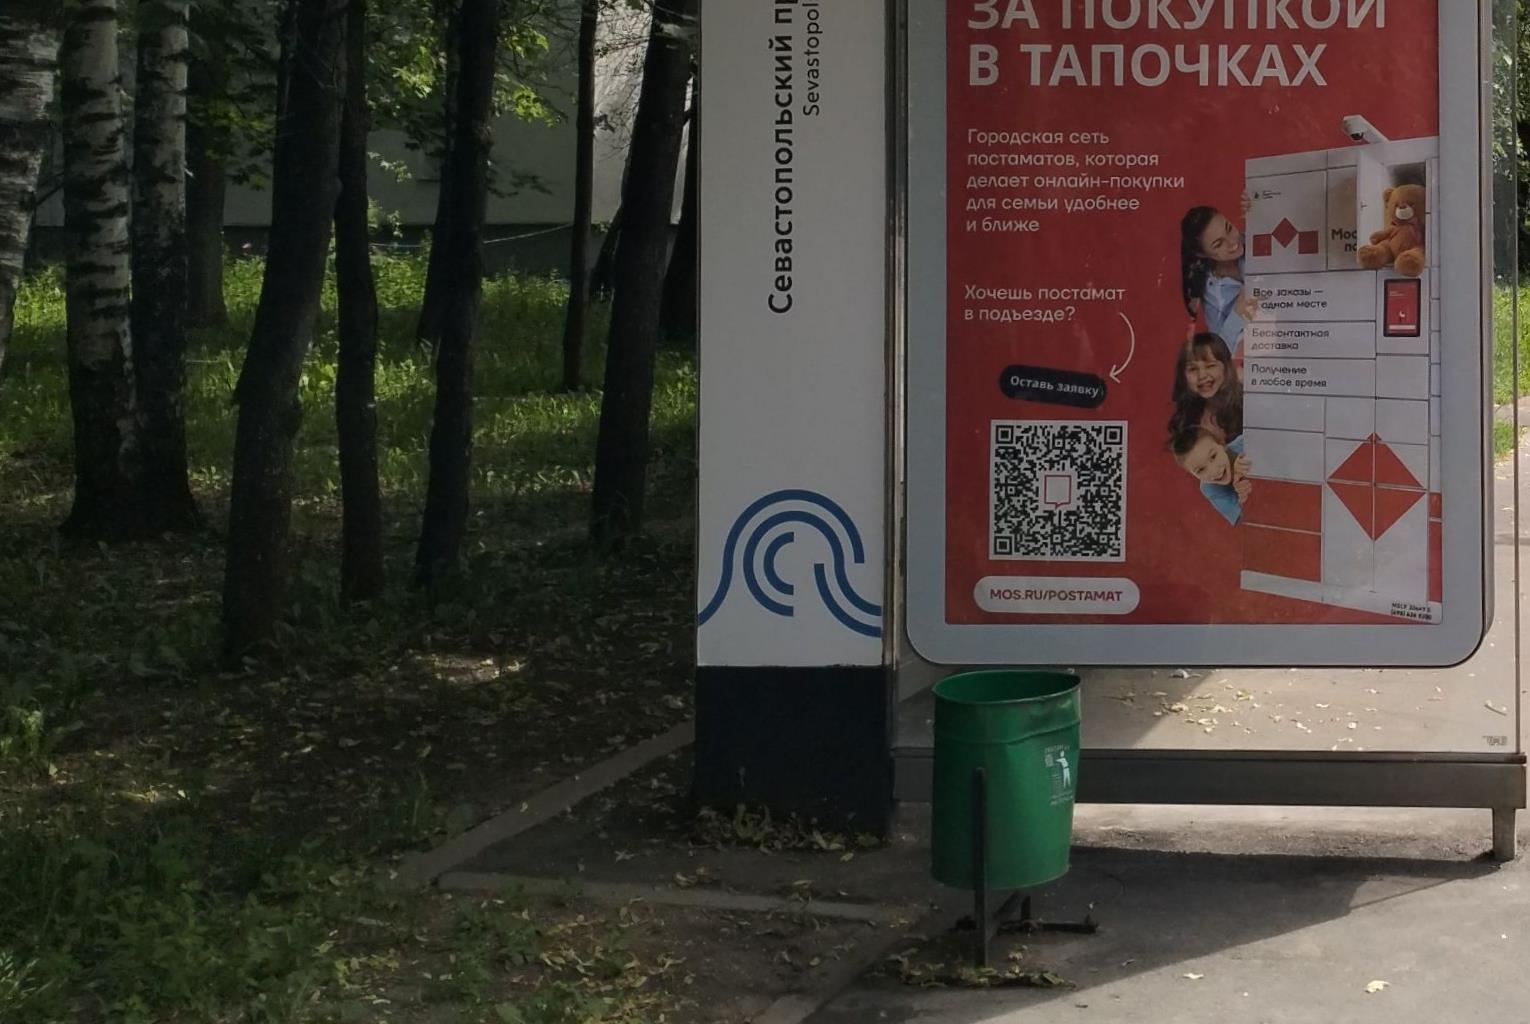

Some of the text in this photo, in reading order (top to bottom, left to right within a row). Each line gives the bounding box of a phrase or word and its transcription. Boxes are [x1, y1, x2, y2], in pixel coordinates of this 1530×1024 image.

[968, 43, 1328, 87] В ТАПОЧКАХ
[967, 128, 1110, 146] Городская сеть
[967, 152, 1160, 168] постаматов, которая
[767, 35, 793, 314] Севастопольский
[966, 173, 1185, 191] делает онлайн-покупки
[966, 195, 1140, 213] для семьи удобнее
[966, 217, 1040, 232] и ближе
[964, 285, 1126, 301] Хочешь постамат
[964, 306, 1076, 323] в подъезде?
[1010, 376, 1099, 398] Оставь заявку
[989, 588, 1124, 602] MOS.RU/POSTAMAT
